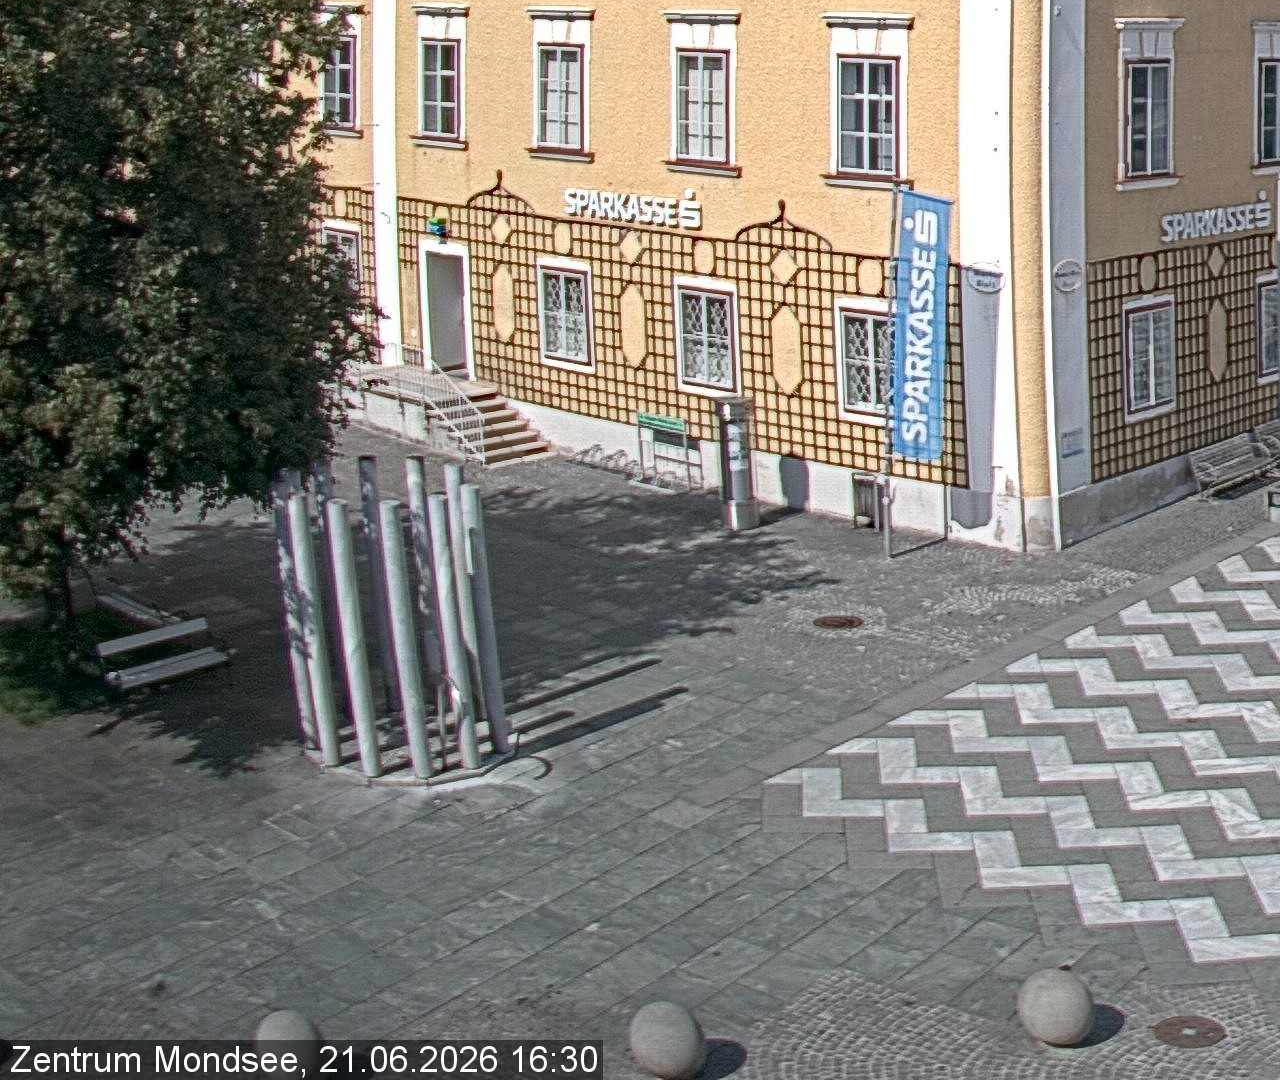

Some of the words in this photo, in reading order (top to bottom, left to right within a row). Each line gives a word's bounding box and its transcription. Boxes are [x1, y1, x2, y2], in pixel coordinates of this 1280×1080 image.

[564, 187, 679, 227] SPARKASSE
[1160, 204, 1256, 242] SPARKASSE
[902, 246, 937, 444] SPARKASSE
